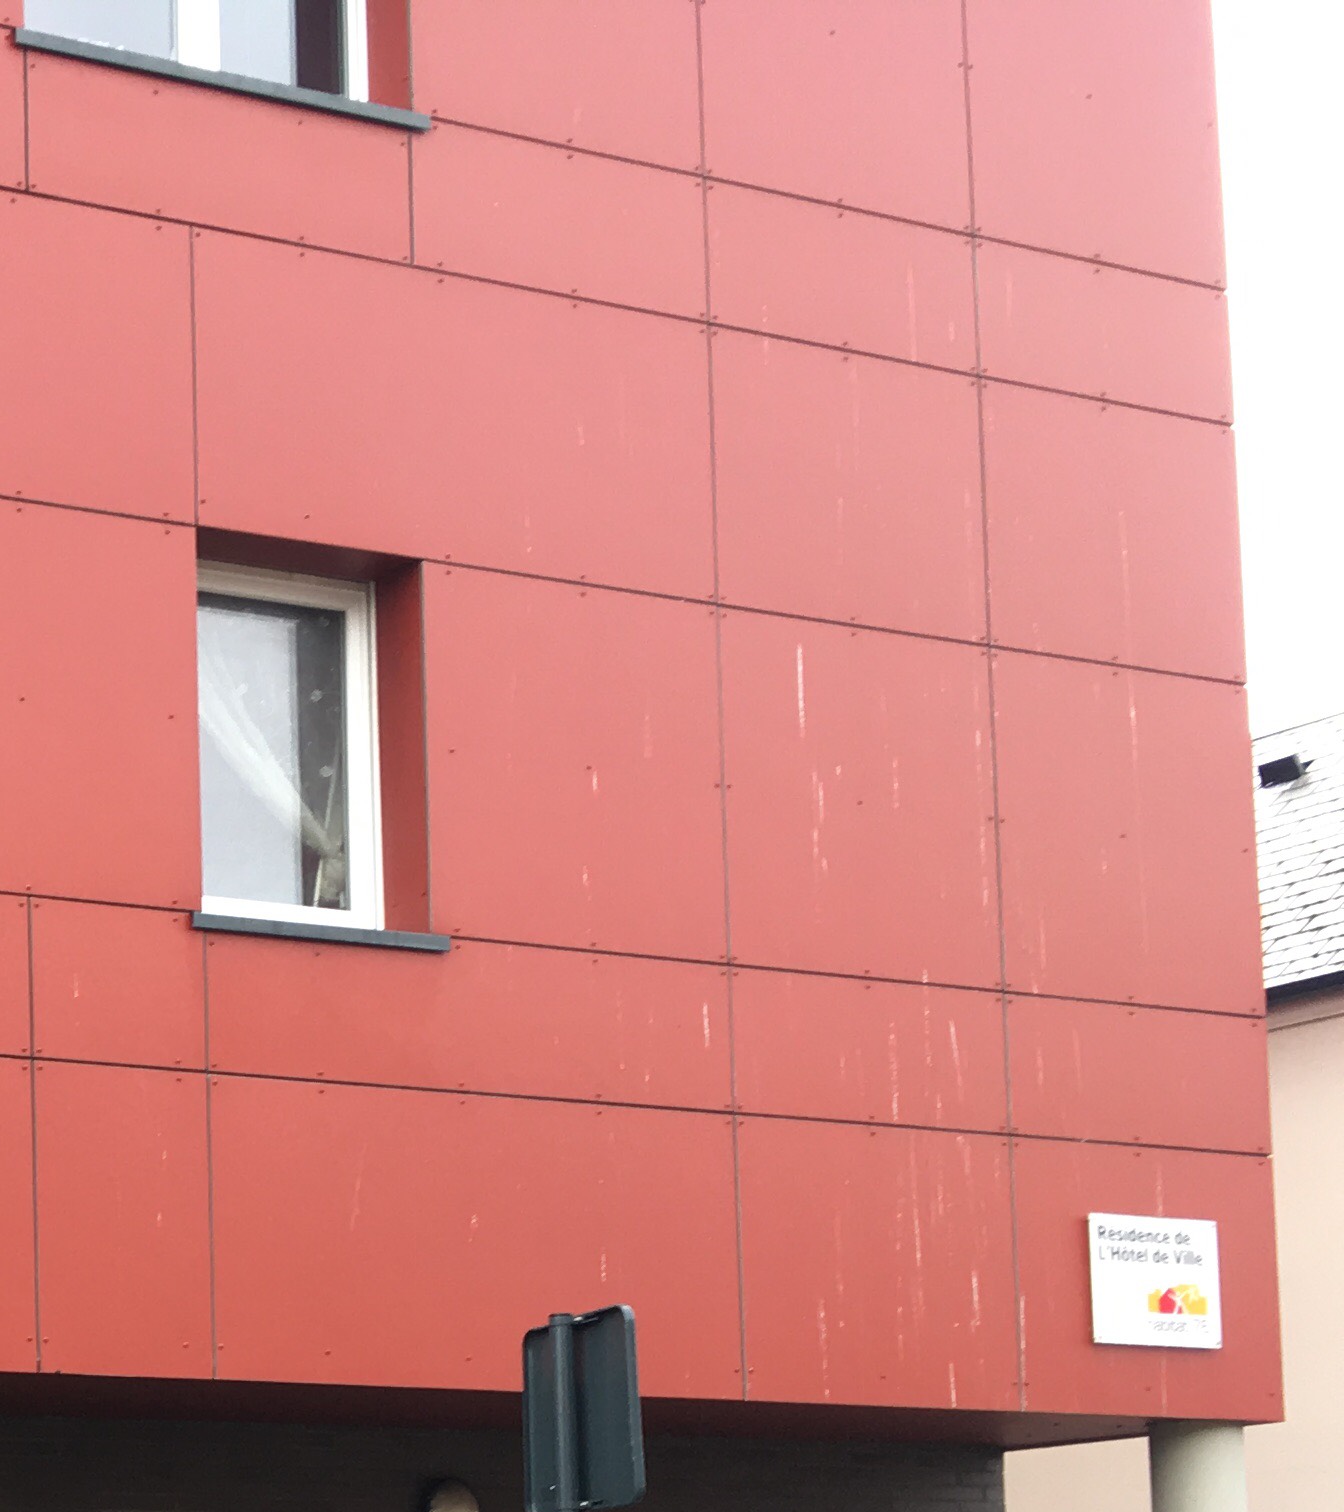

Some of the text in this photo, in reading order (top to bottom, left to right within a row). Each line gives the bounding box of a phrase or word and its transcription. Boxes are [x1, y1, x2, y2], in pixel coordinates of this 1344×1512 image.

[1174, 1230, 1191, 1245] de
[1152, 1249, 1169, 1264] de
[1173, 1250, 1203, 1266] Ville
